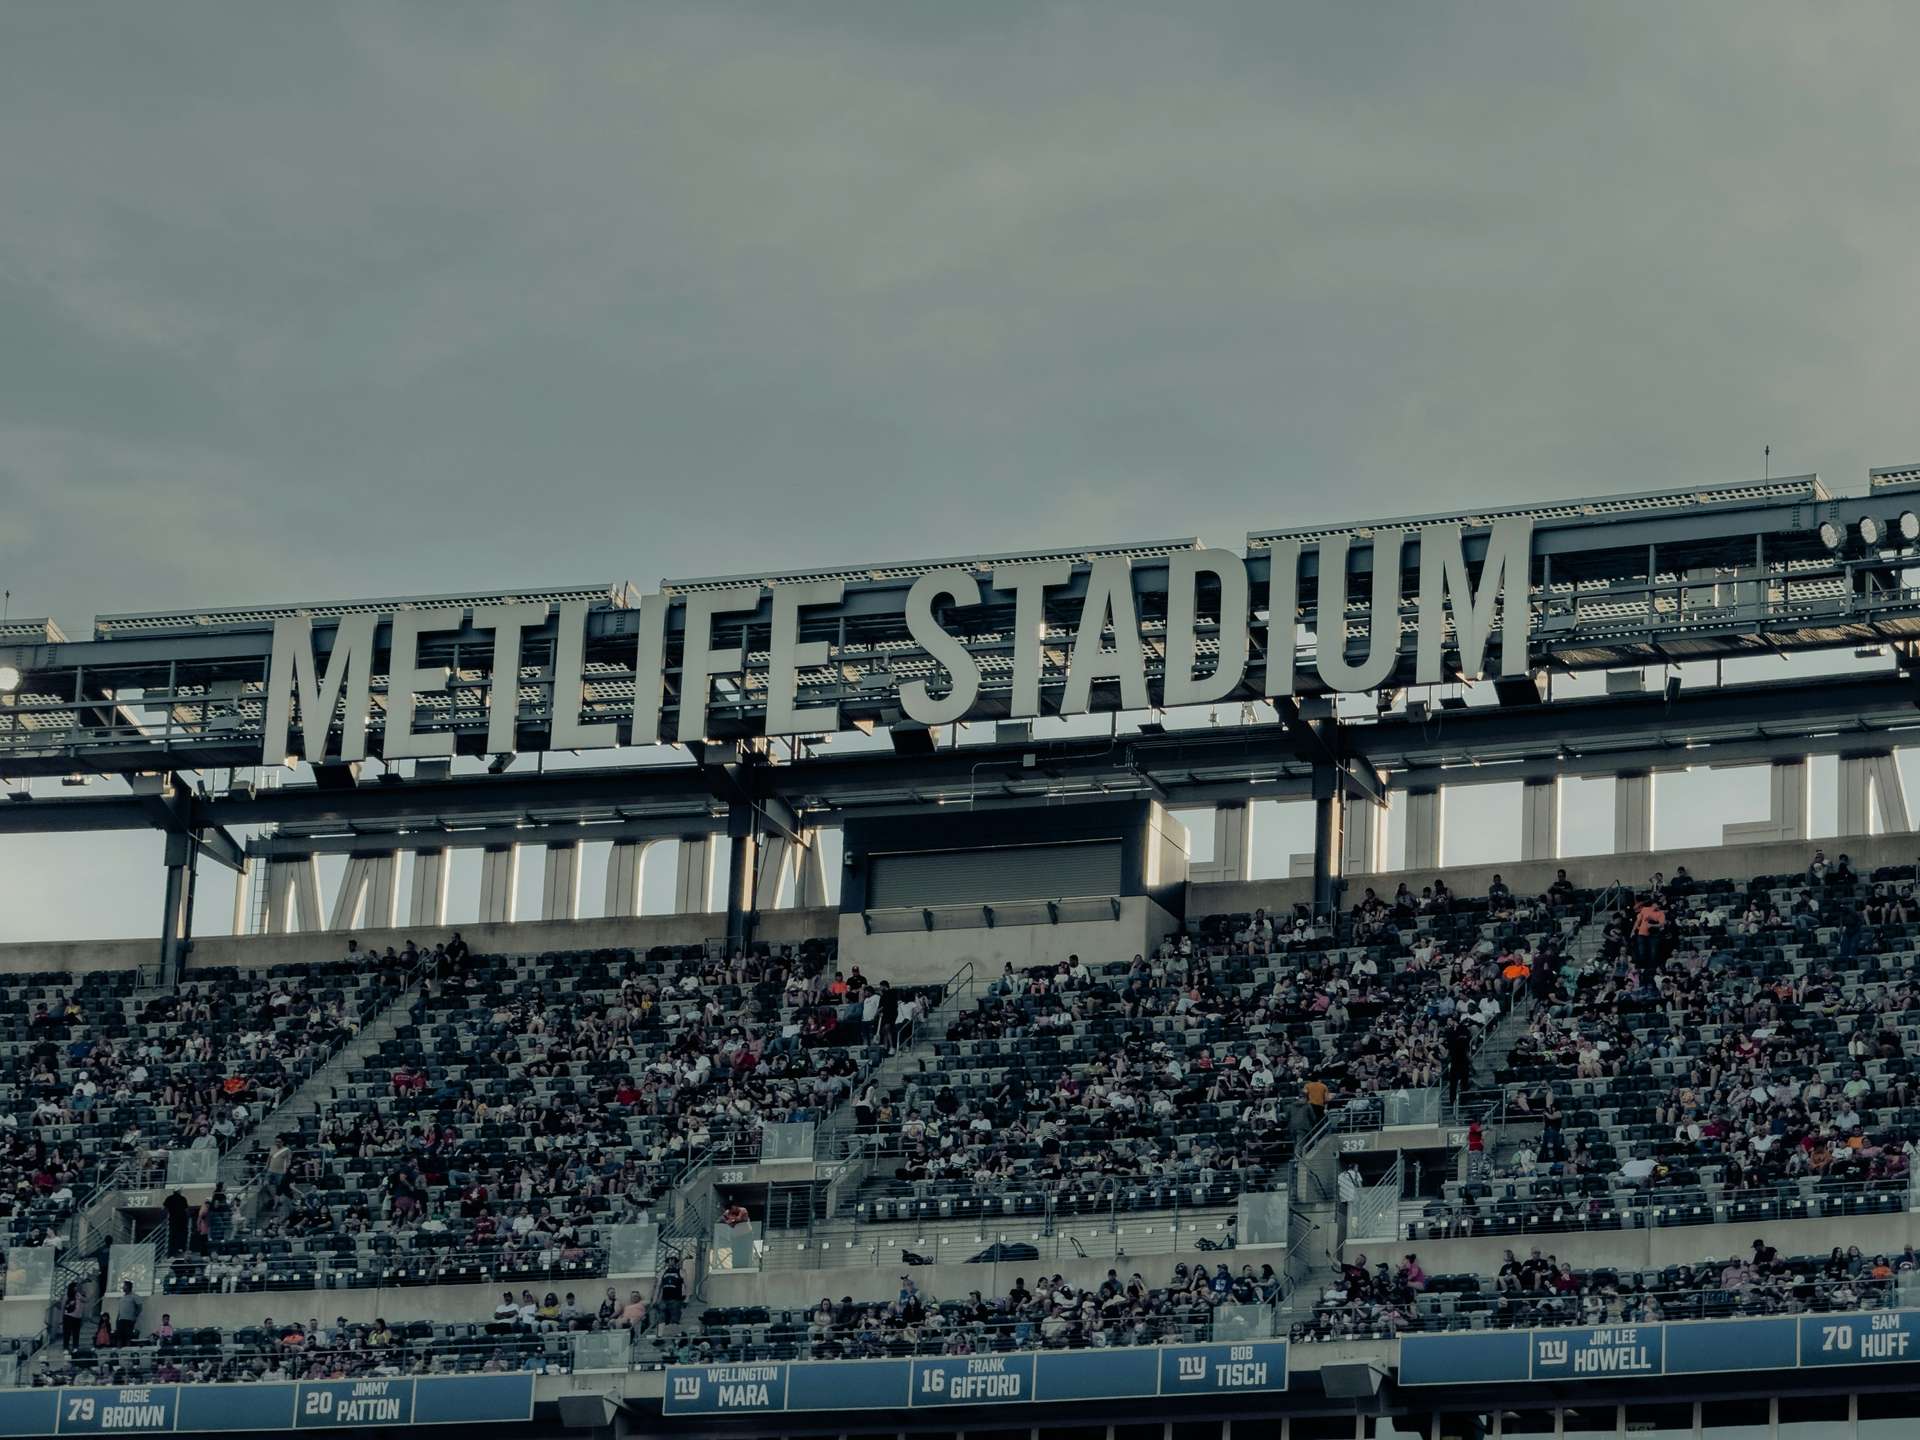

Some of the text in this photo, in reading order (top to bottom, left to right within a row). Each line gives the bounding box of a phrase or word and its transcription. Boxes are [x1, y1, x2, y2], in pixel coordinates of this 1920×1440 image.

[263, 517, 1532, 767] METLIFE STADIUM
[1342, 1139, 1365, 1151] 339
[721, 1171, 743, 1183] 338
[127, 1196, 148, 1208] 337
[1872, 1314, 1900, 1330] SAM
[1589, 1329, 1637, 1345] JIM LEE
[1823, 1325, 1852, 1351] 70
[1860, 1332, 1910, 1357] HUFF
[1230, 1346, 1253, 1360] BOB
[1574, 1346, 1652, 1372] HOWELL
[707, 1366, 778, 1383] WELLINGTON
[967, 1358, 1006, 1373] FRANK
[1215, 1363, 1267, 1387] TISCH
[352, 1381, 389, 1396] JIMMY
[921, 1368, 945, 1392] 16
[950, 1374, 1020, 1399] GIFFORD
[119, 1389, 151, 1403] ROSIE
[305, 1391, 333, 1414] 20
[718, 1384, 769, 1407] MARA
[68, 1398, 95, 1421] 79
[101, 1406, 165, 1428] BROWN
[336, 1398, 400, 1421] PATTON
